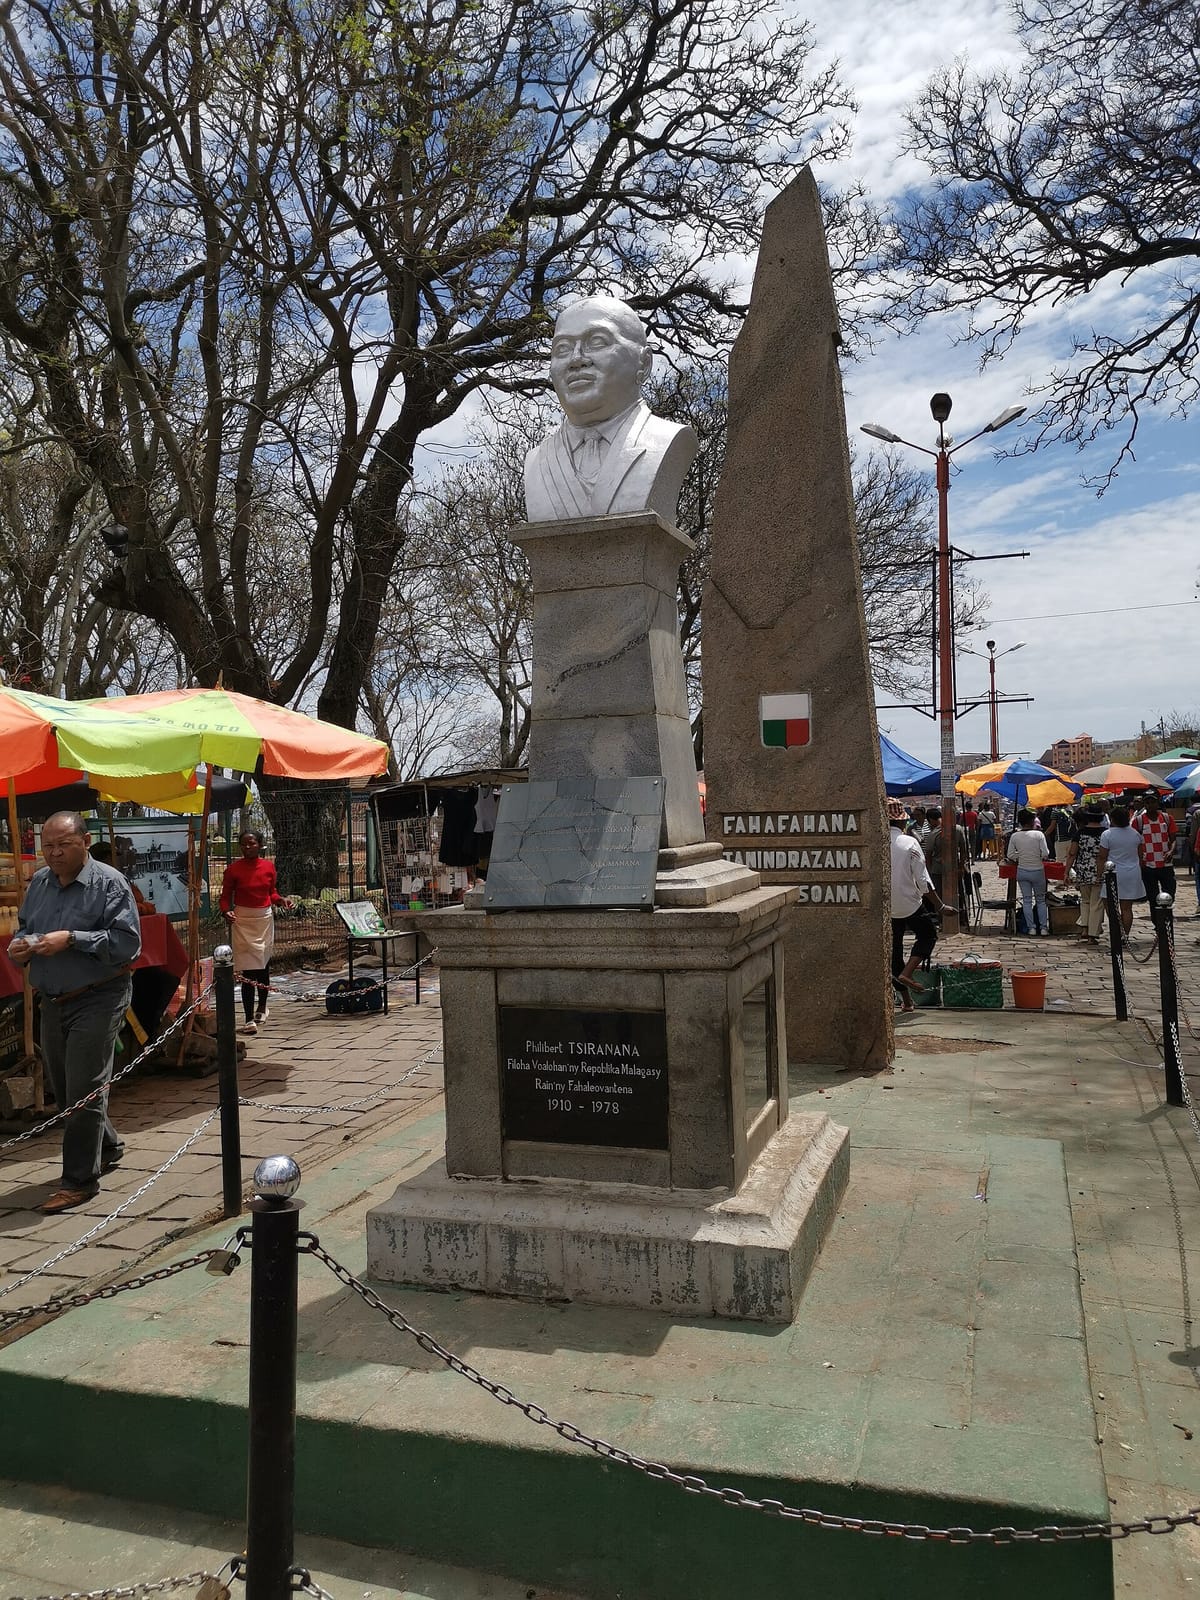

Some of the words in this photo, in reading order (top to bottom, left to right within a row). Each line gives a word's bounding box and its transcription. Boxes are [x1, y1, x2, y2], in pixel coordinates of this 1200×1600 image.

[723, 814, 858, 835] FAHAFAHANA
[722, 850, 862, 869] TANINDRAZANA
[526, 1040, 564, 1054] Philibert
[568, 1041, 641, 1057] TSIRANANA
[507, 1058, 530, 1070] Filoha
[580, 1061, 620, 1077] Repoblika
[621, 1063, 662, 1080] Malagasy
[548, 1099, 573, 1112] 1910
[591, 1101, 620, 1114] 1978
